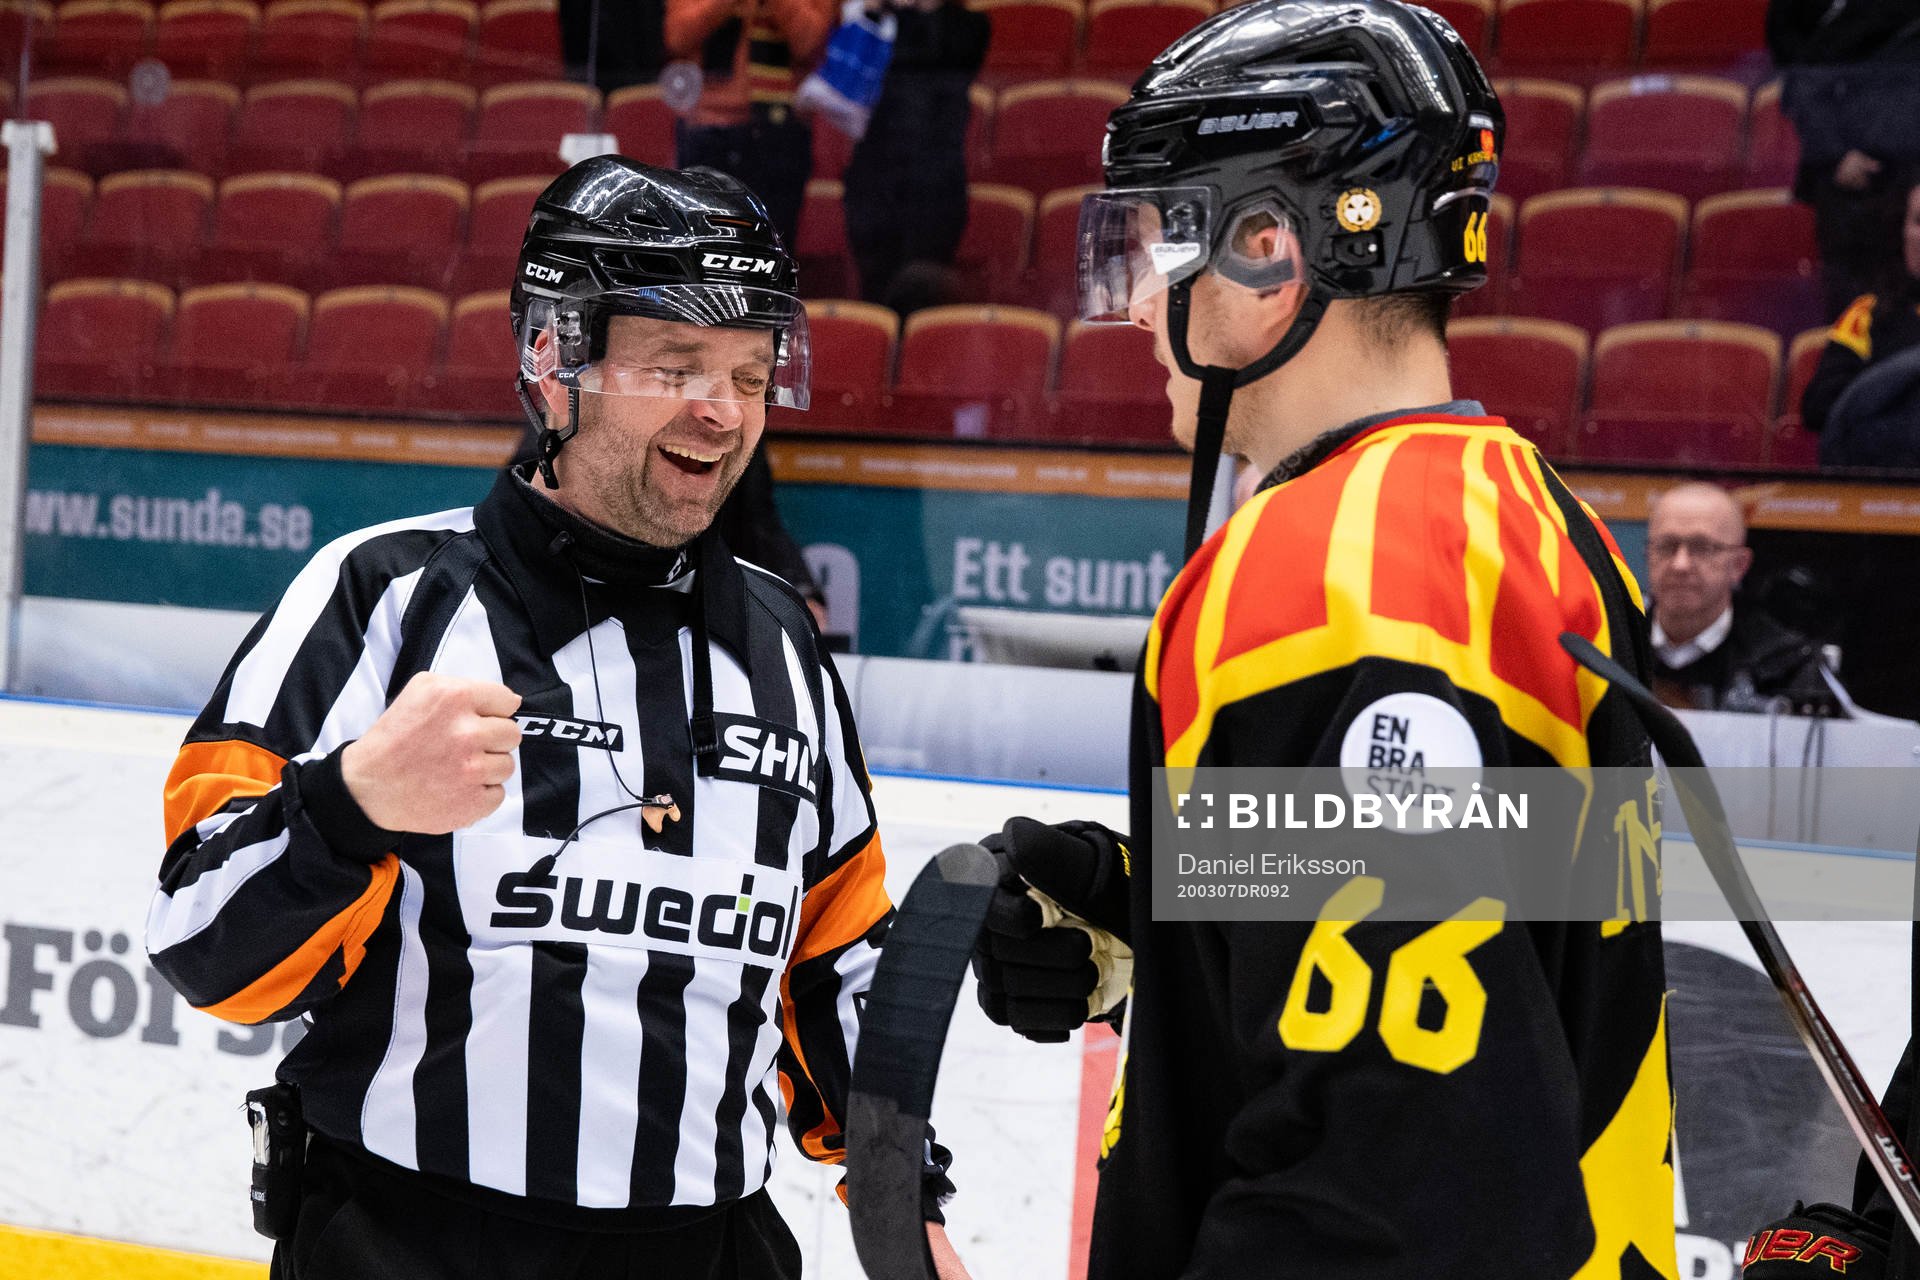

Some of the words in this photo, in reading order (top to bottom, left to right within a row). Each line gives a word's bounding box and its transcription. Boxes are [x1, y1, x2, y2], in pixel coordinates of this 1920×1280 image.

[1197, 110, 1299, 135] BAUER
[1464, 211, 1488, 263] 66
[525, 261, 564, 284] CCM
[701, 252, 776, 274] CCM
[558, 371, 576, 379] CCM
[954, 537, 1031, 601] Ett
[514, 715, 620, 746] CCM
[1372, 713, 1408, 744] EN
[719, 724, 817, 796] SHL
[1368, 744, 1425, 777] BRA
[1278, 875, 1507, 1075] 66
